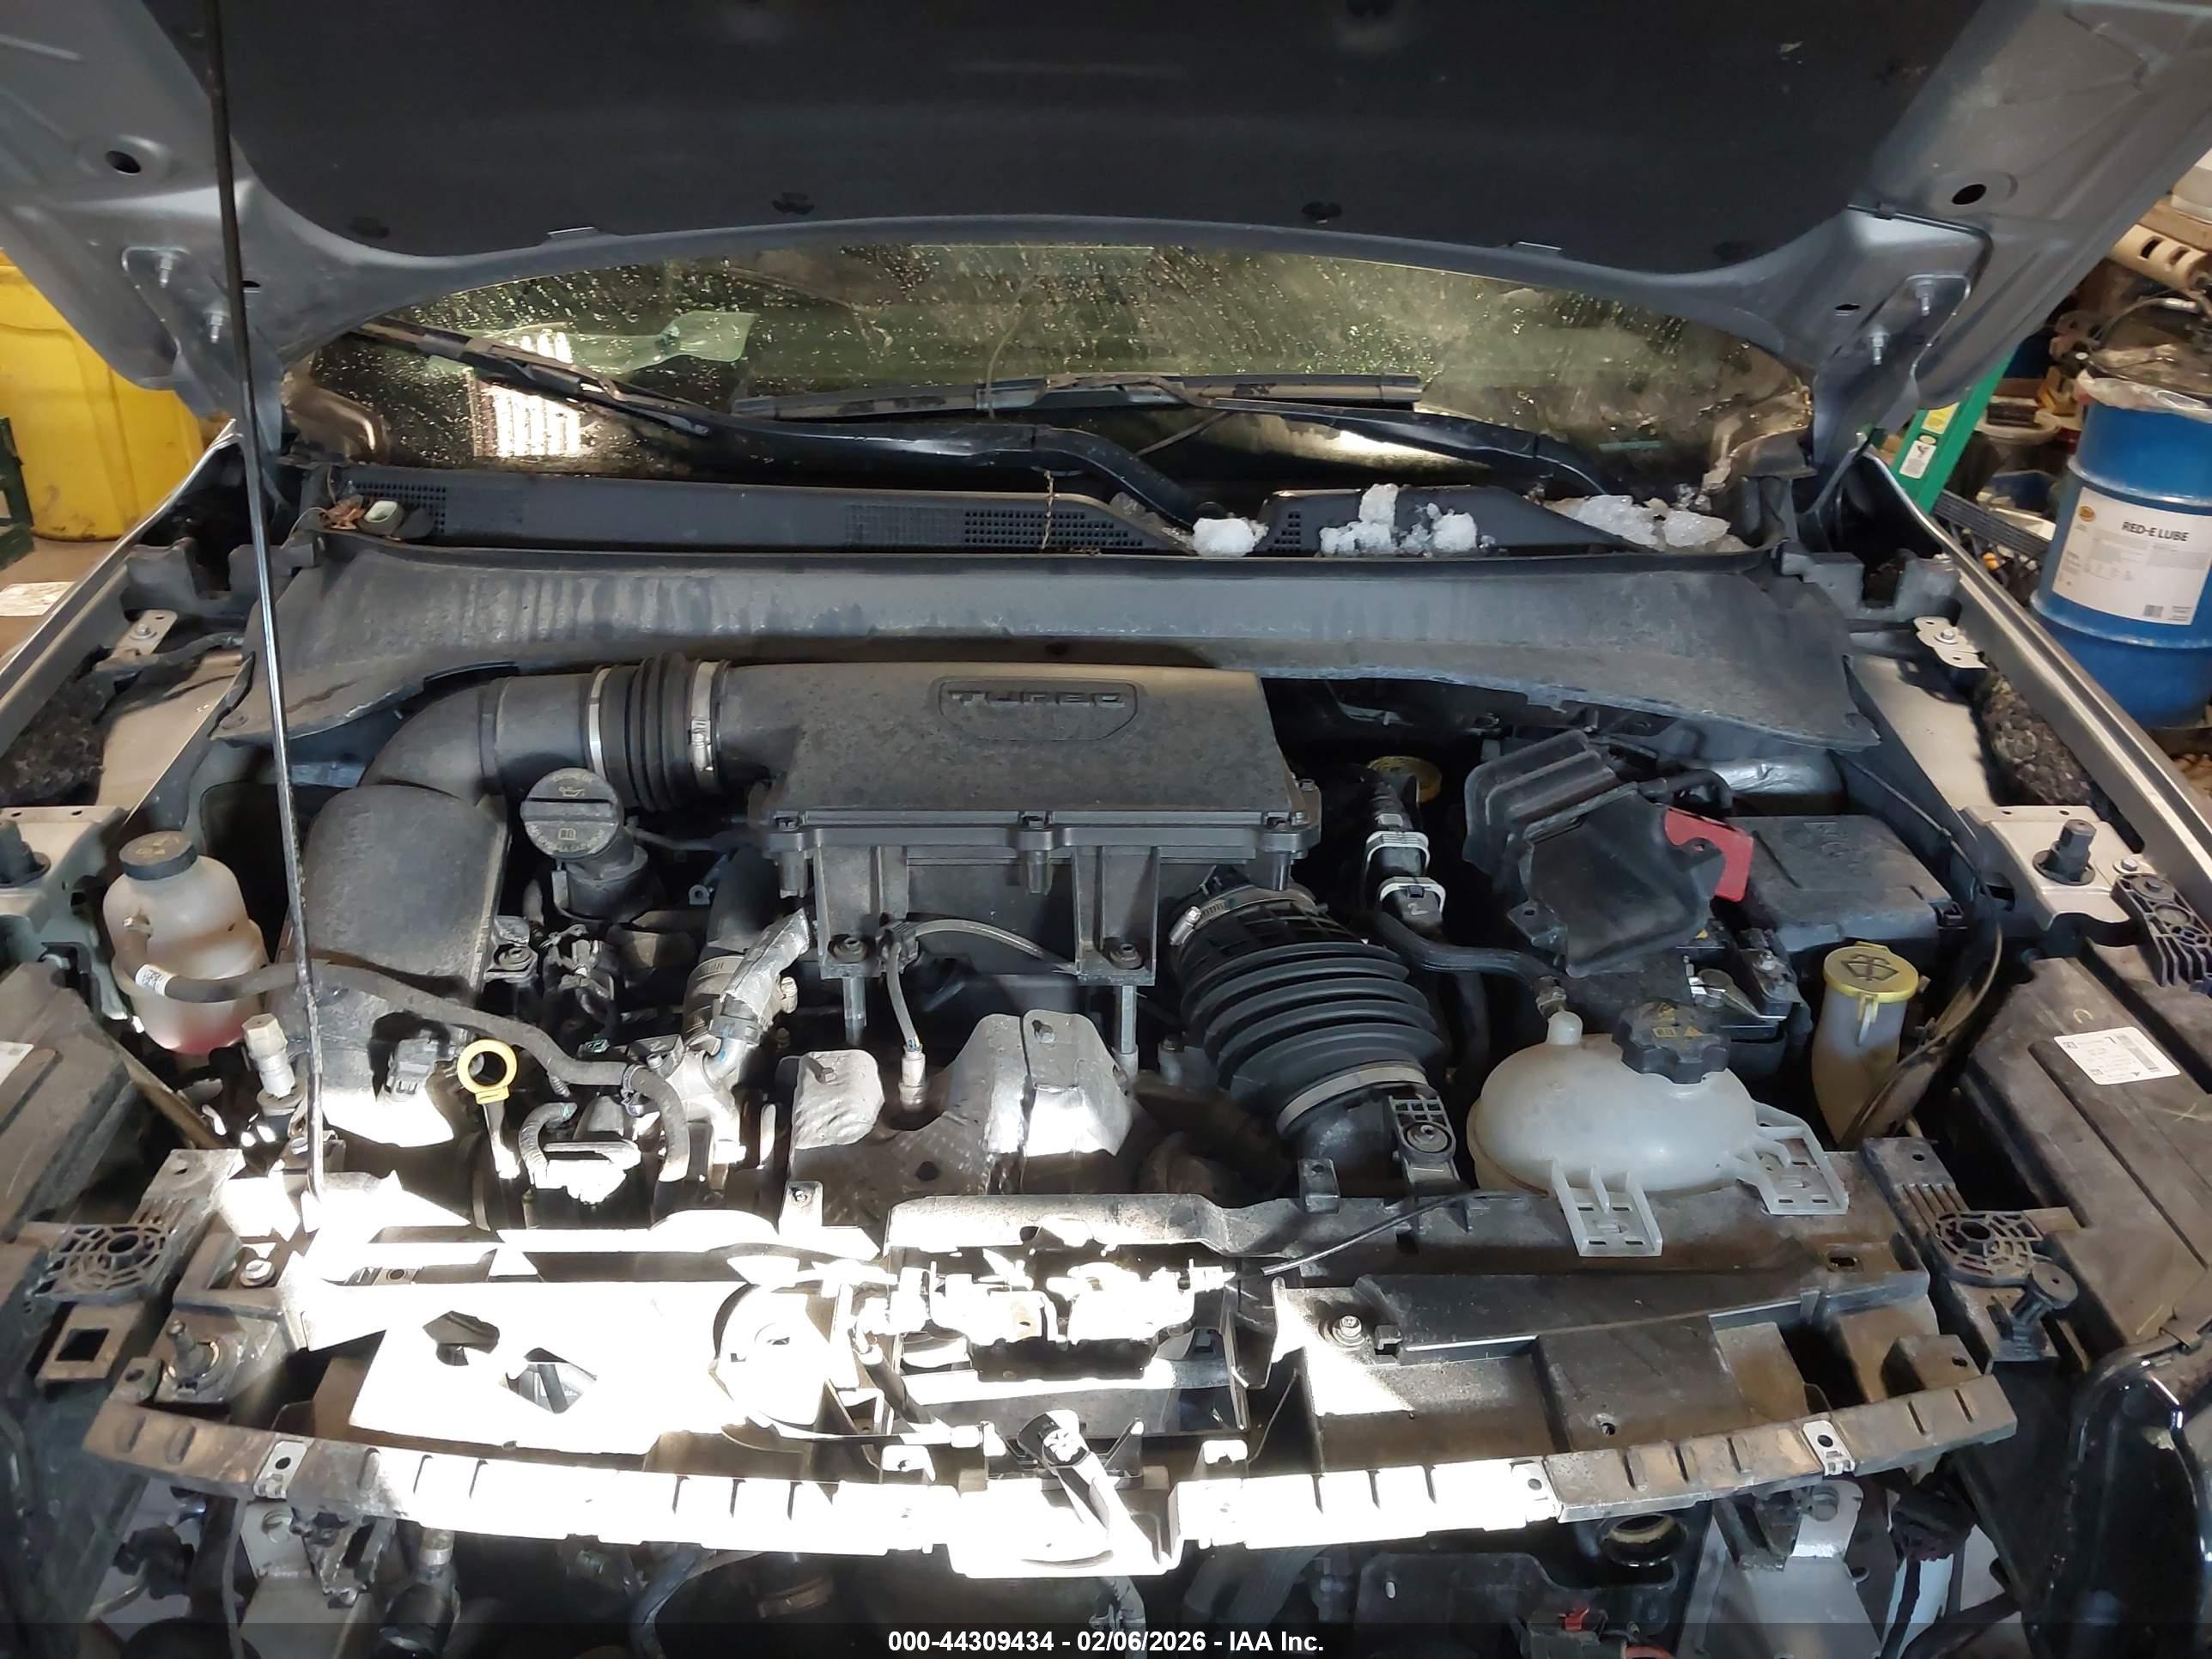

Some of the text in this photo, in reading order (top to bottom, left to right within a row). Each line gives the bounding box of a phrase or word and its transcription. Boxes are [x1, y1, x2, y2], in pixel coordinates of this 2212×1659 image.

[2121, 520, 2157, 538] RED-E
[2158, 527, 2191, 543] LUBE
[947, 690, 1126, 708] TURBO
